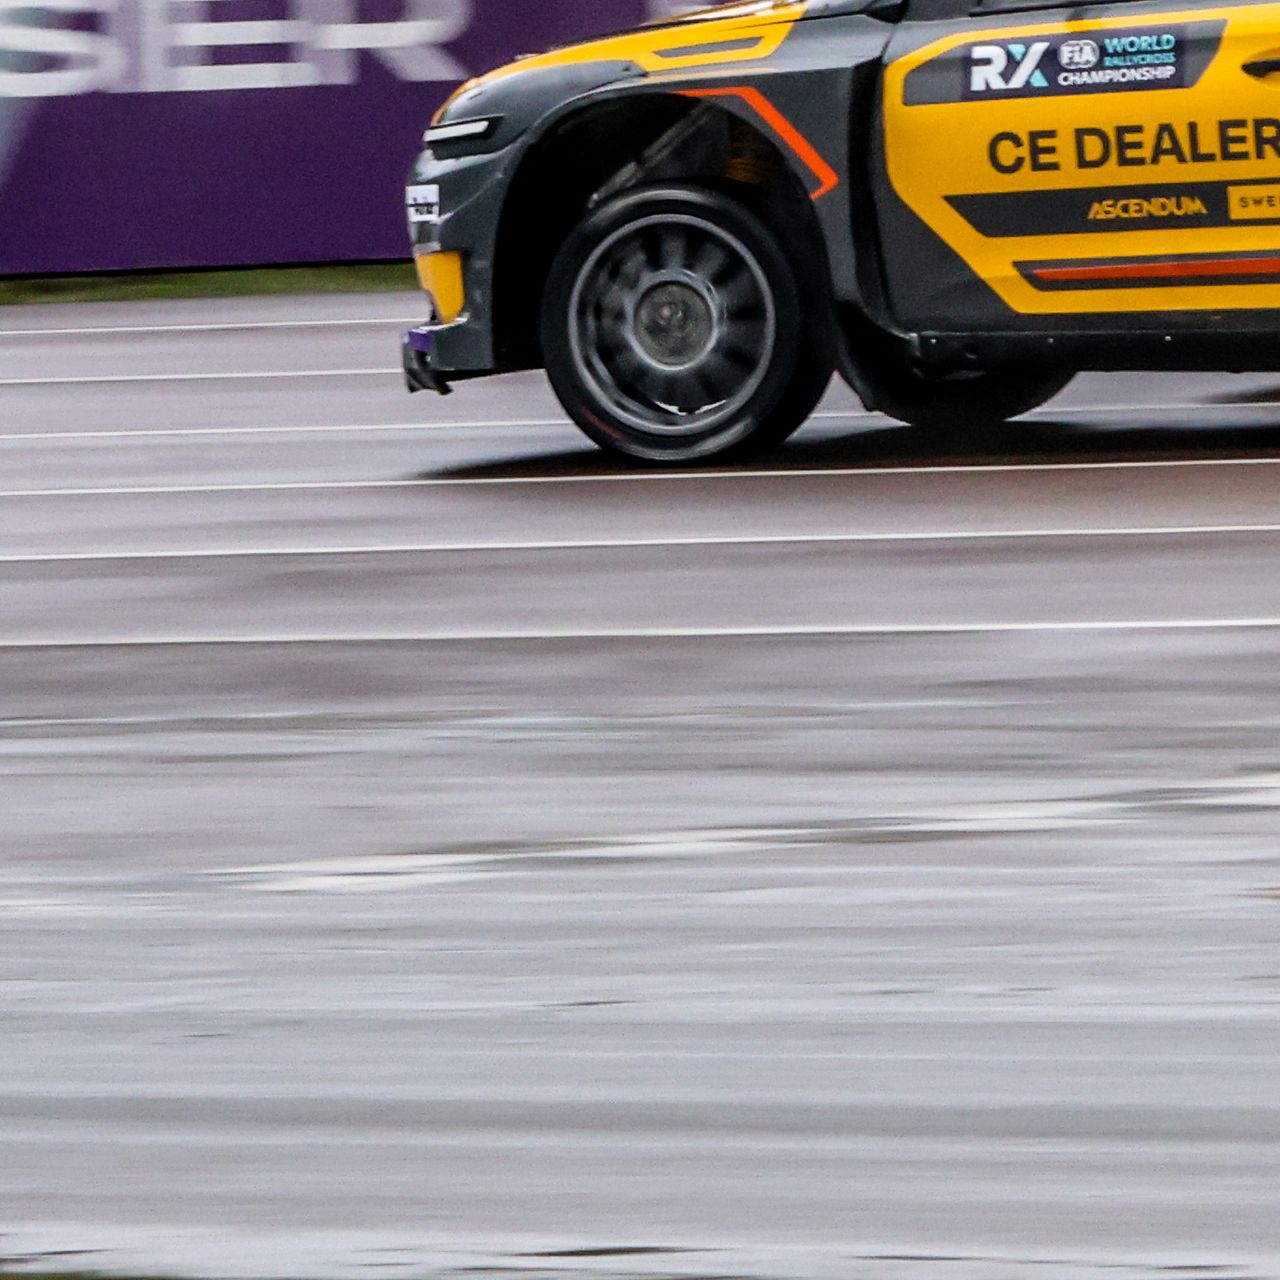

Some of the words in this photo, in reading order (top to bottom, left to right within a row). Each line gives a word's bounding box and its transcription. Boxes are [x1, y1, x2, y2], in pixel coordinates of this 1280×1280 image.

[1103, 34, 1176, 54] WORLD
[970, 42, 1050, 91] RX
[1057, 66, 1176, 86] CHAMPIONSHIP
[988, 130, 1060, 174] CE
[1087, 196, 1209, 219] ASCENDUM
